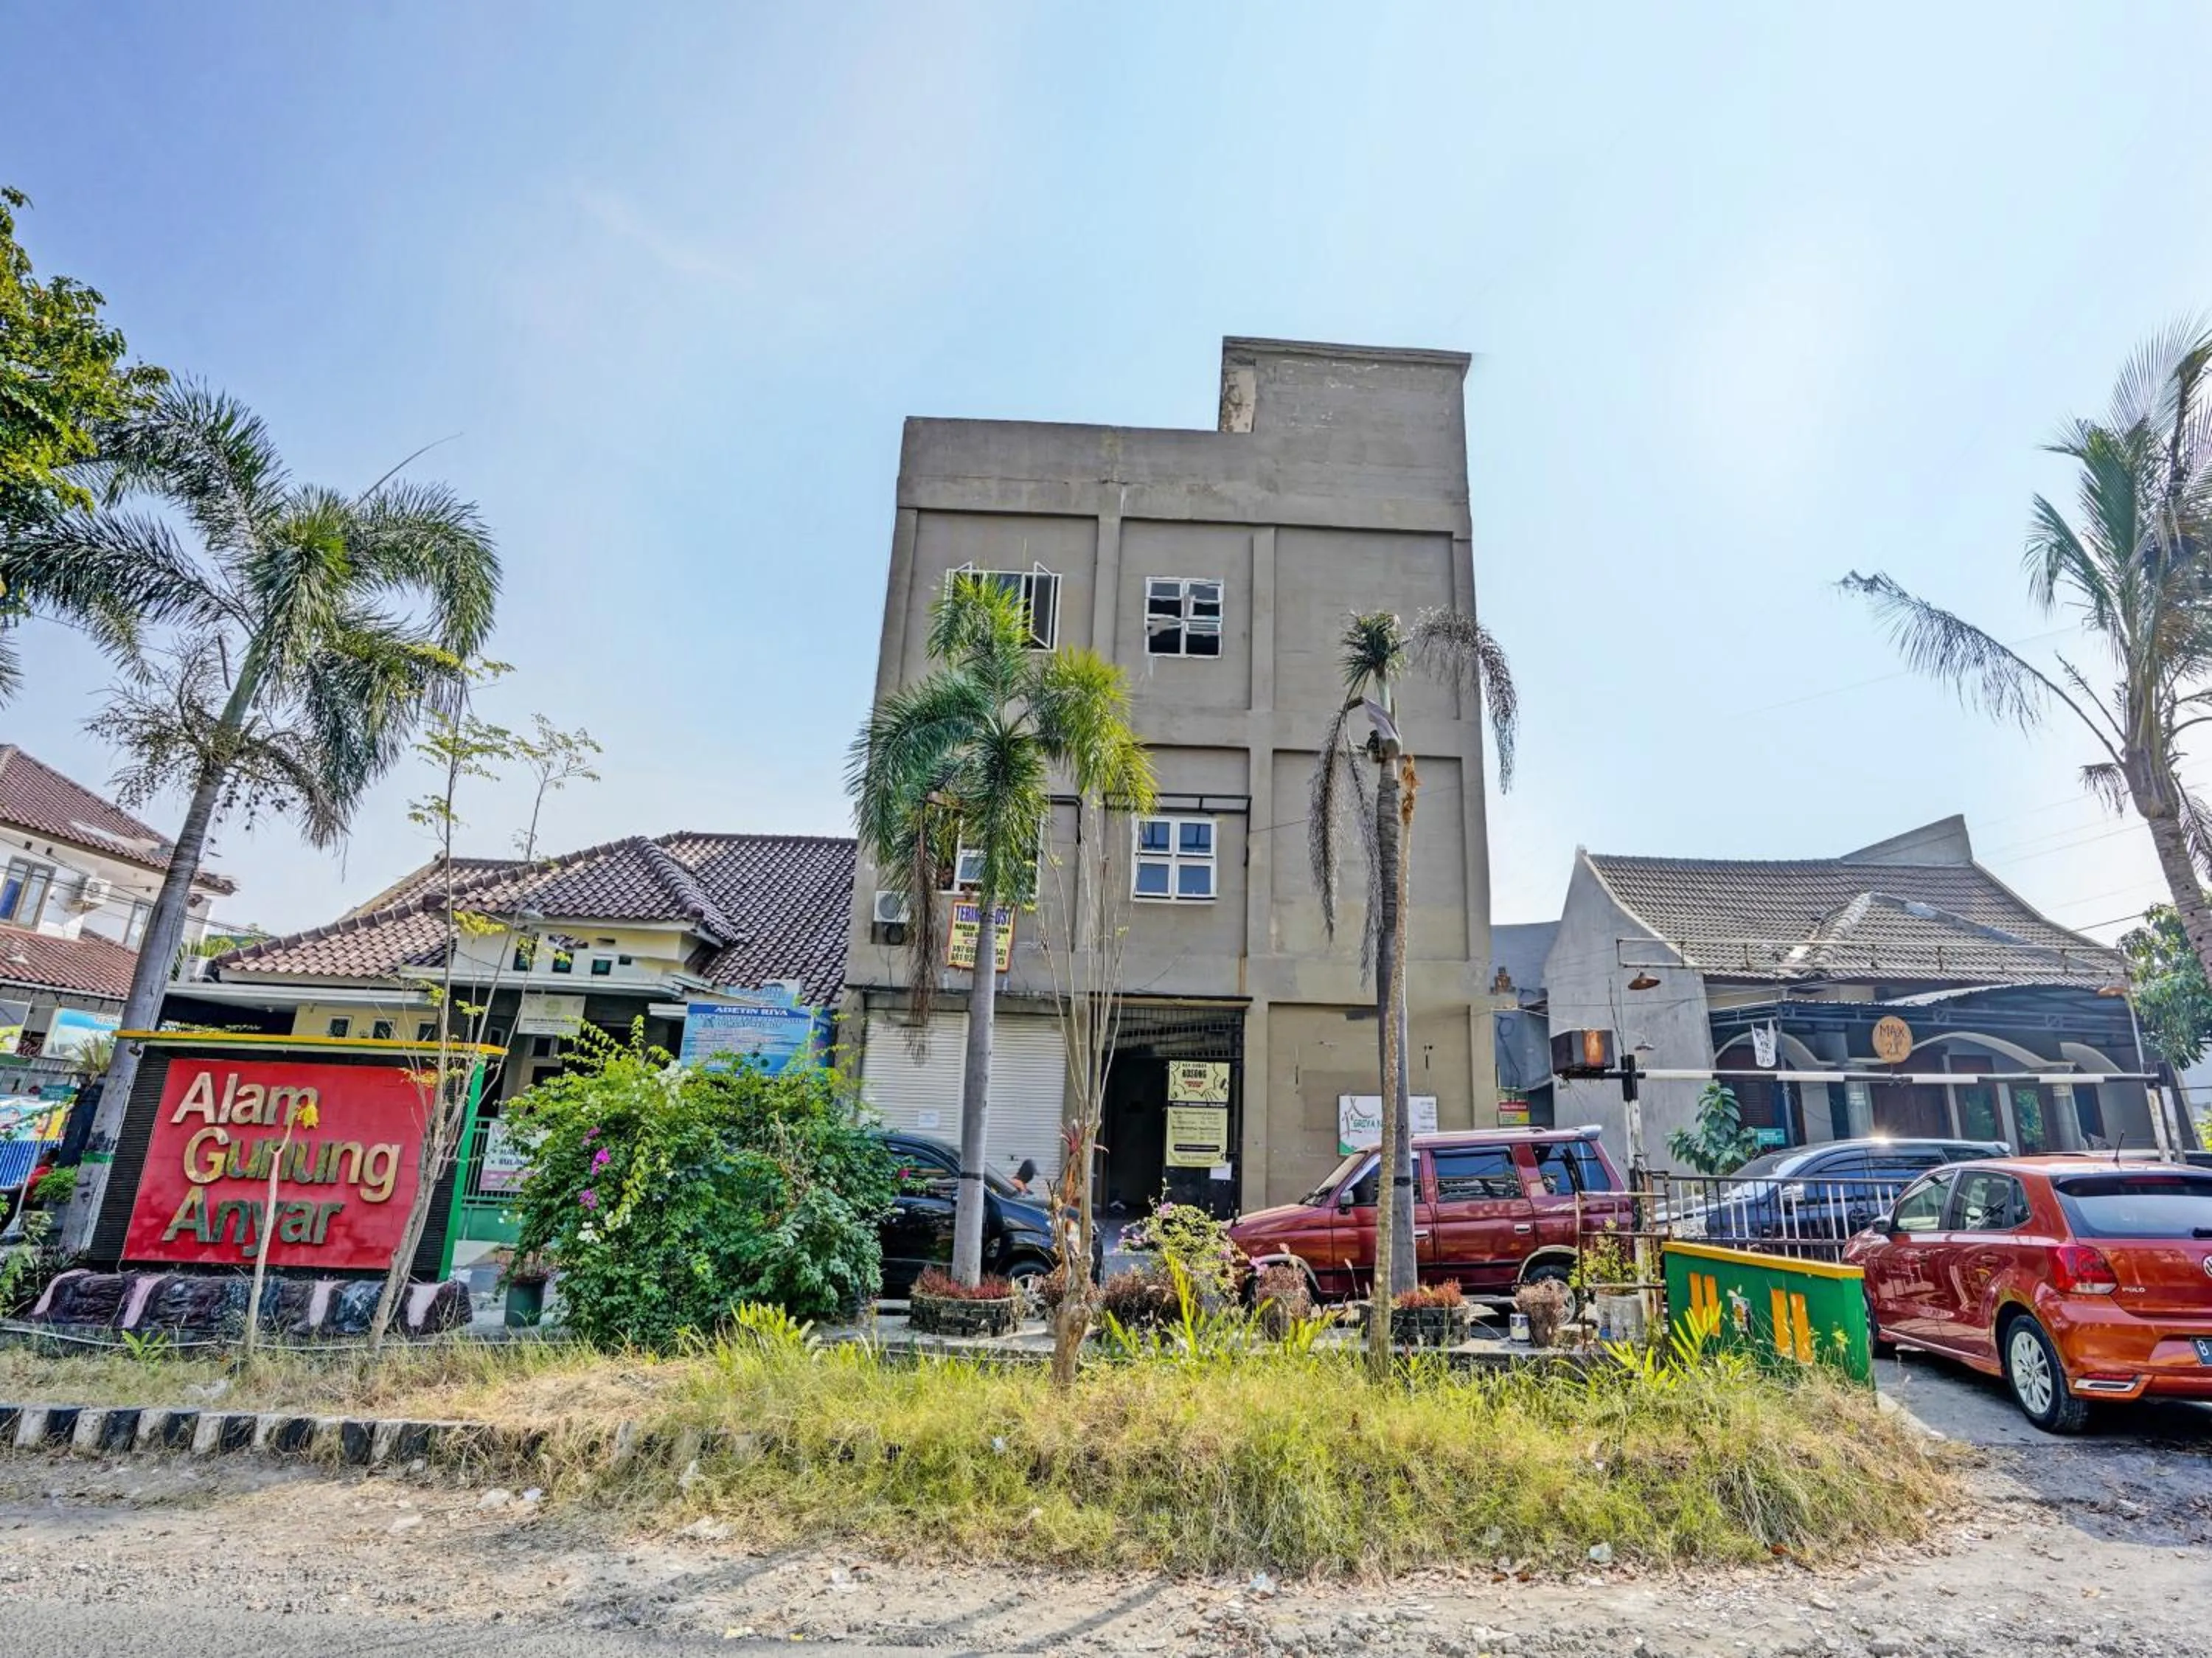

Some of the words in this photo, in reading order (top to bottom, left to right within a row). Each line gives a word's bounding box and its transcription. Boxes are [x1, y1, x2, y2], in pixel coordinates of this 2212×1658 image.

[760, 1007, 788, 1016] RIVA
[170, 1072, 319, 1126] Alam
[183, 1126, 402, 1204] Gunung
[161, 1185, 345, 1258] Anyar
